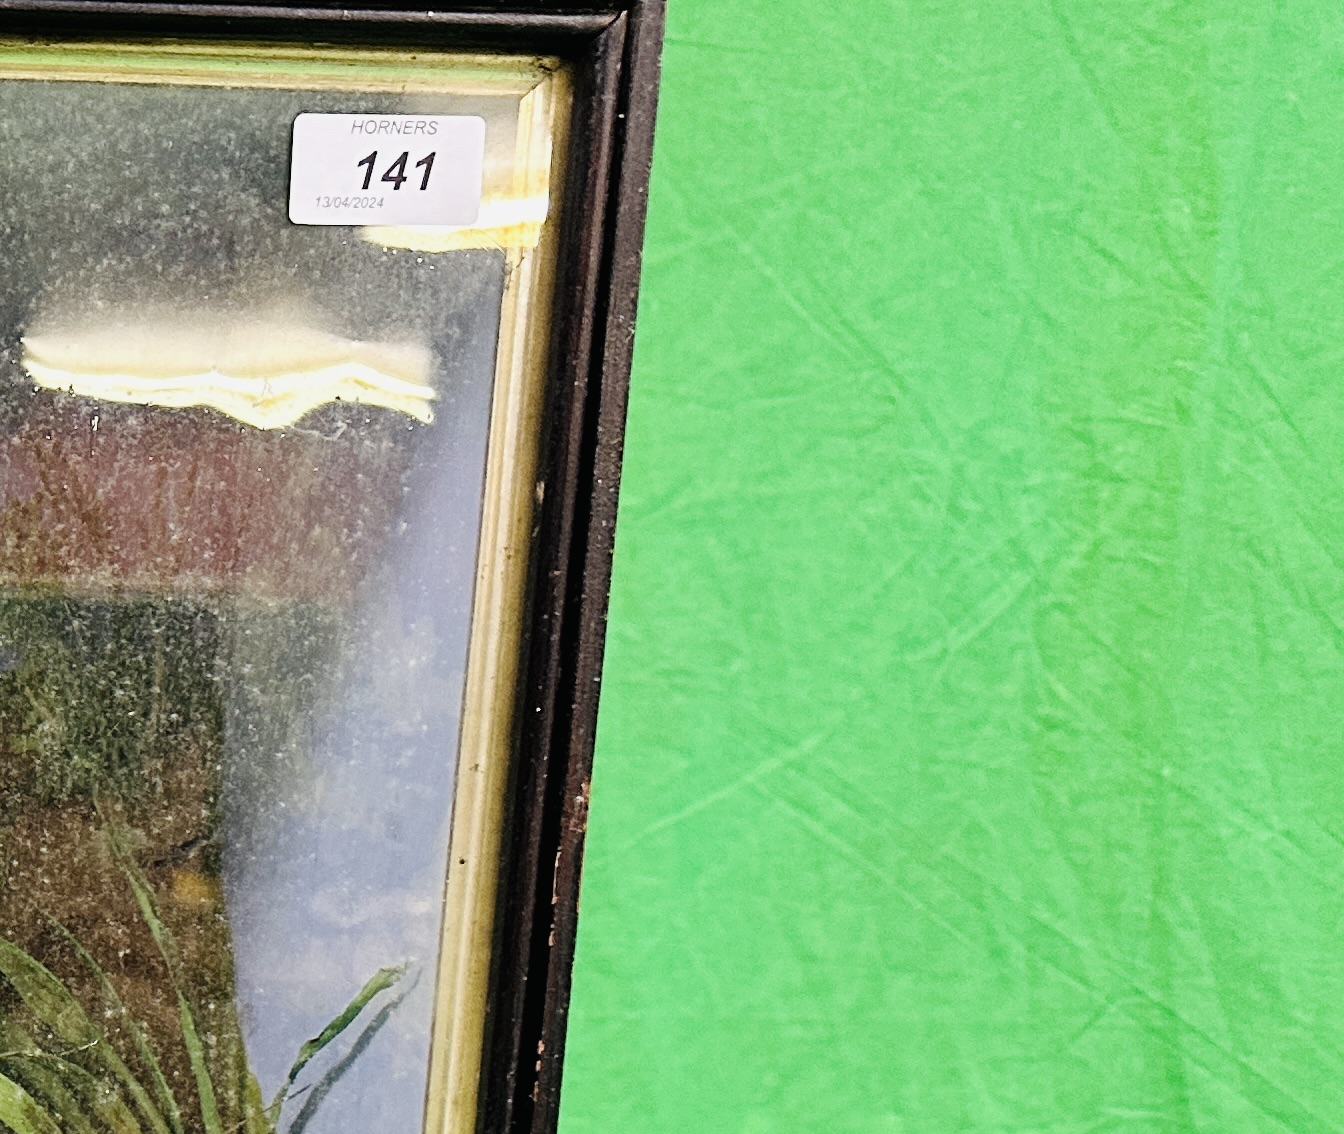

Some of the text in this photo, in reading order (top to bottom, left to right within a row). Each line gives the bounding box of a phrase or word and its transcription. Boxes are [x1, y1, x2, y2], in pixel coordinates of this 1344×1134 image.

[351, 119, 439, 135] HORNERS
[357, 150, 437, 191] 141
[315, 196, 385, 209] 13/04/2024
